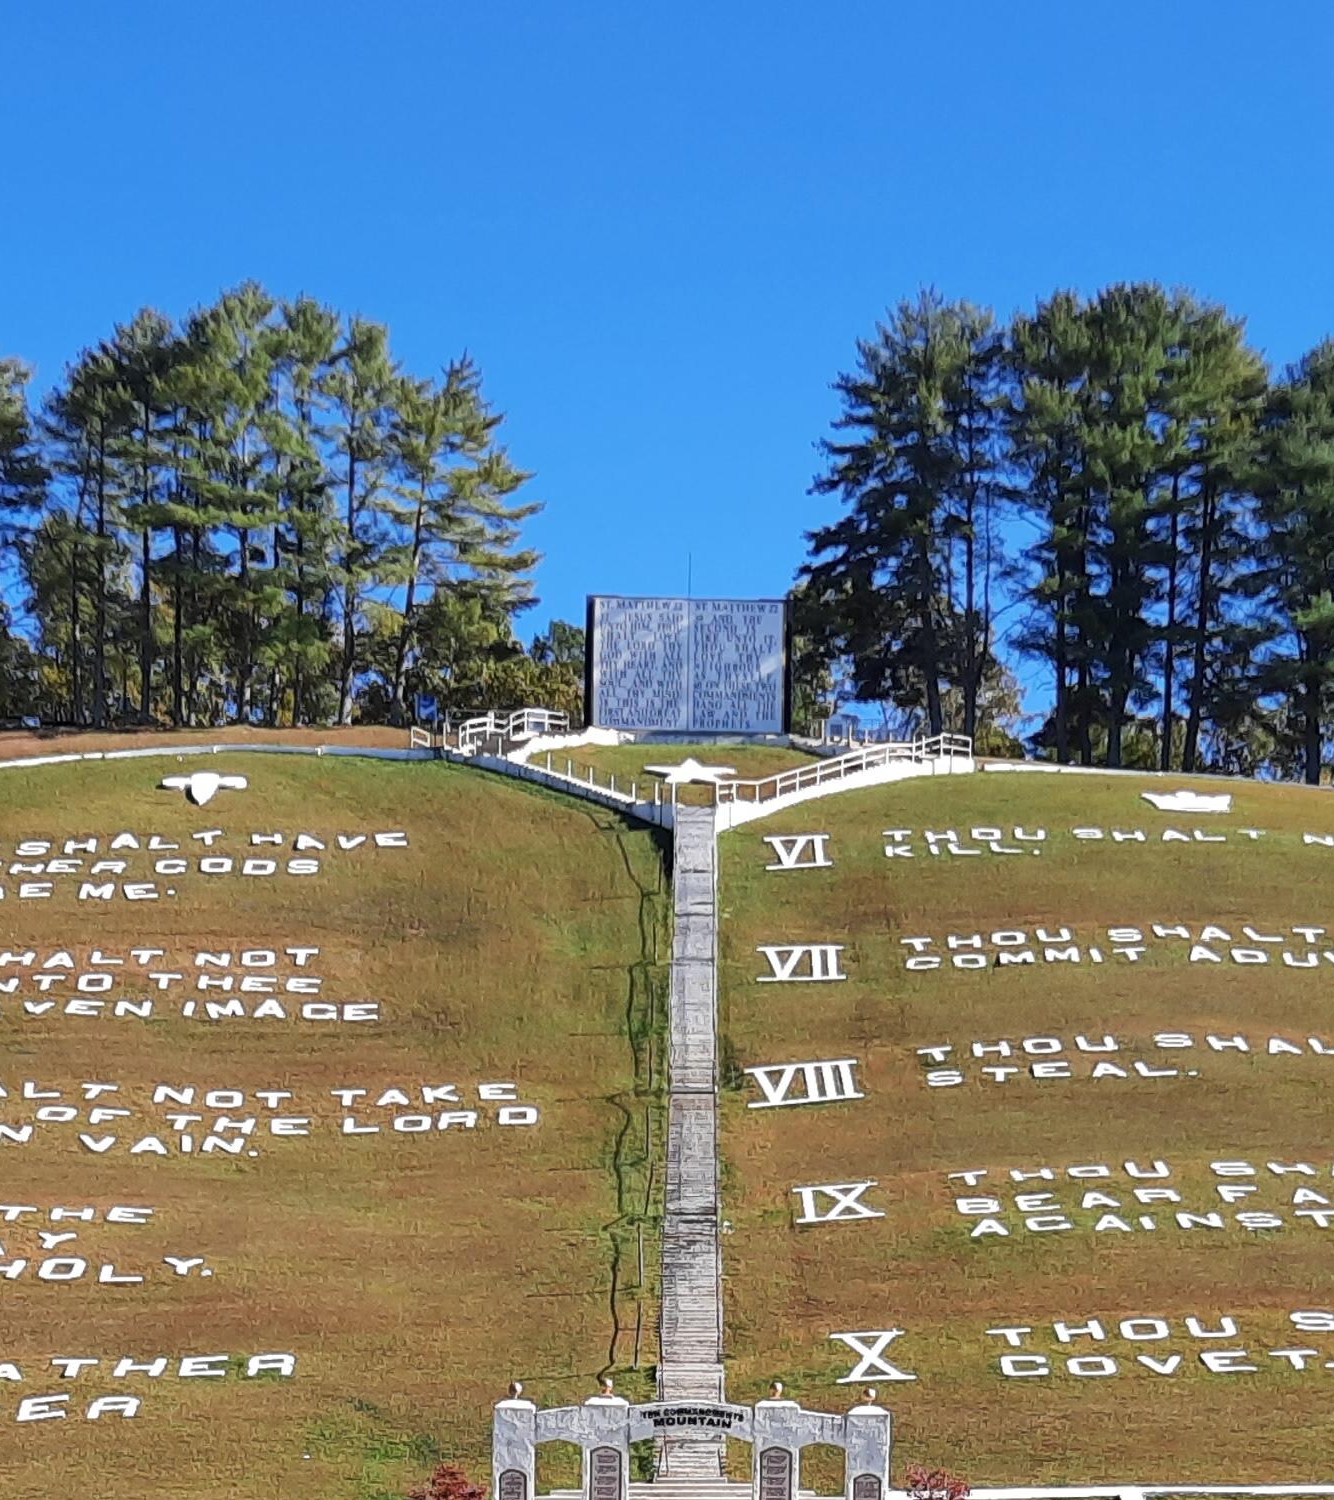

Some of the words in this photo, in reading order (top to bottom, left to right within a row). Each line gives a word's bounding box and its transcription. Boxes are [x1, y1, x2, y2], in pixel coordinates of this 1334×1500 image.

[15, 829, 222, 856] SHALT
[251, 832, 408, 850] HAVE
[882, 826, 1046, 844] THOU
[1072, 828, 1263, 842] SHALT
[763, 834, 833, 871] VI
[154, 857, 319, 875] GODS
[900, 928, 1072, 952] THOU
[1107, 924, 1325, 943] SHALT
[194, 948, 319, 968] NOT
[756, 944, 847, 982] VII
[906, 946, 1146, 970] COMMIT
[148, 972, 322, 993] THEE
[182, 998, 379, 1021] IMAGE
[917, 1035, 1119, 1062] THOU
[153, 1085, 292, 1109] NOT
[330, 1083, 517, 1106] TAKE
[744, 1059, 865, 1108] VIII
[36, 1106, 131, 1124] OF
[166, 1114, 309, 1135] THE
[342, 1106, 538, 1134] LORD
[948, 1160, 1170, 1186] THOU
[792, 1180, 886, 1224] IX
[955, 1188, 1181, 1214] BEAR
[985, 1316, 1237, 1346] THOU
[829, 1327, 917, 1384] X
[653, 1416, 732, 1429] MOUNTAIN
